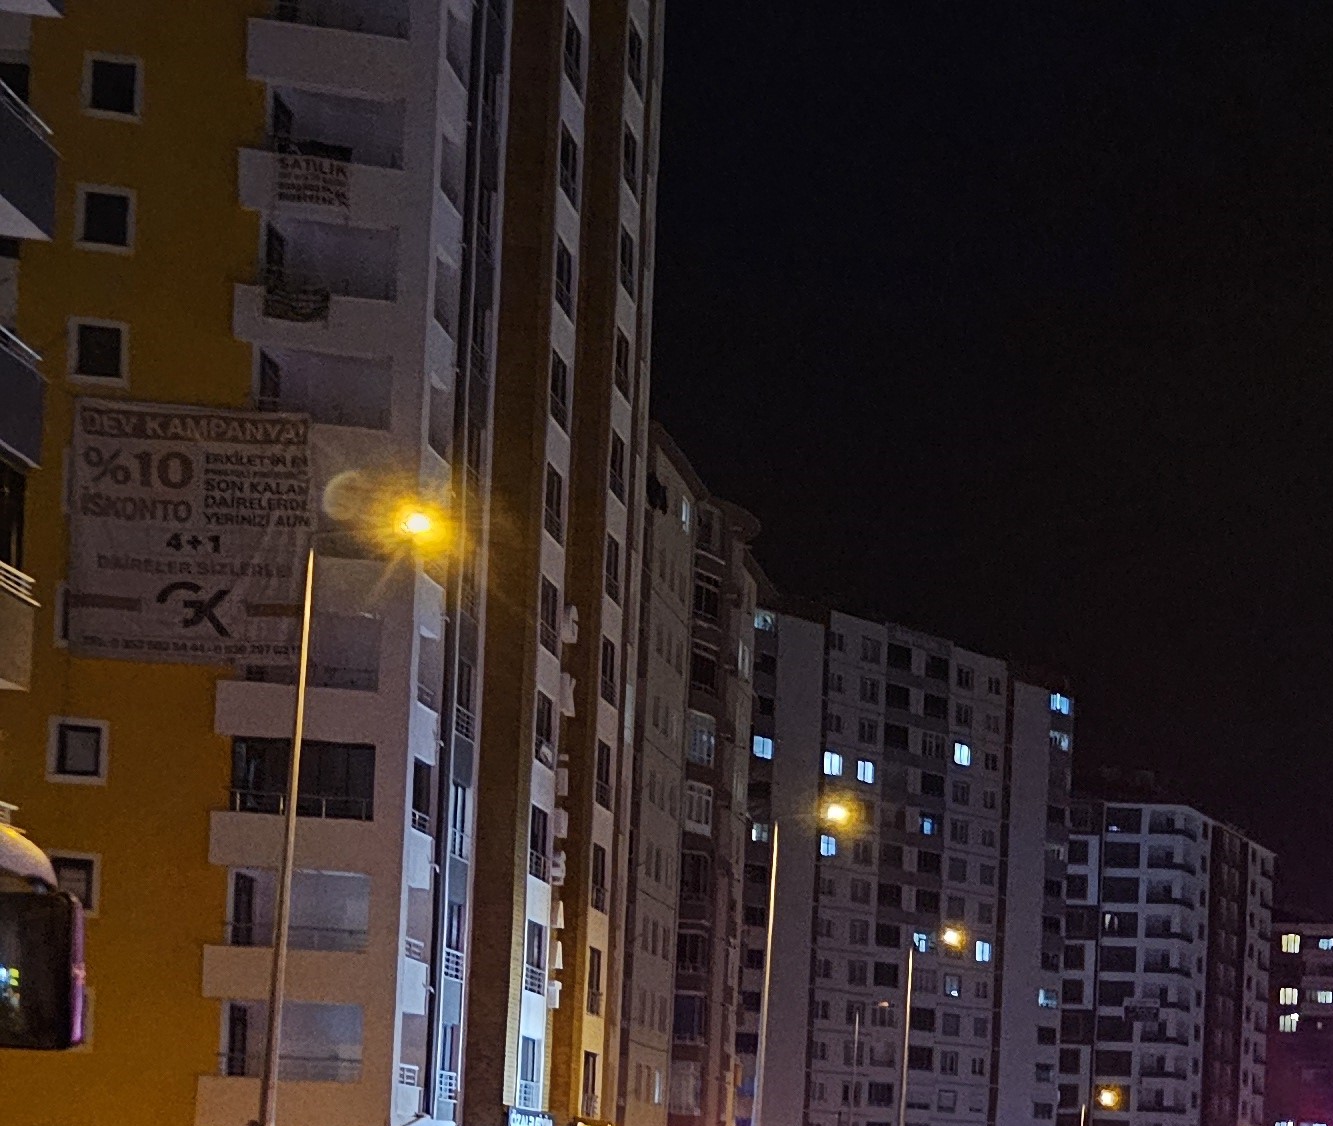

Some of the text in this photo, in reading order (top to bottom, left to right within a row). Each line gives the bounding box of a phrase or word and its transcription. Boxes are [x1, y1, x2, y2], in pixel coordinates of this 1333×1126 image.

[279, 158, 348, 179] SATILIK
[84, 446, 195, 489] %10
[205, 479, 244, 492] SON
[166, 533, 221, 554] 4+1
